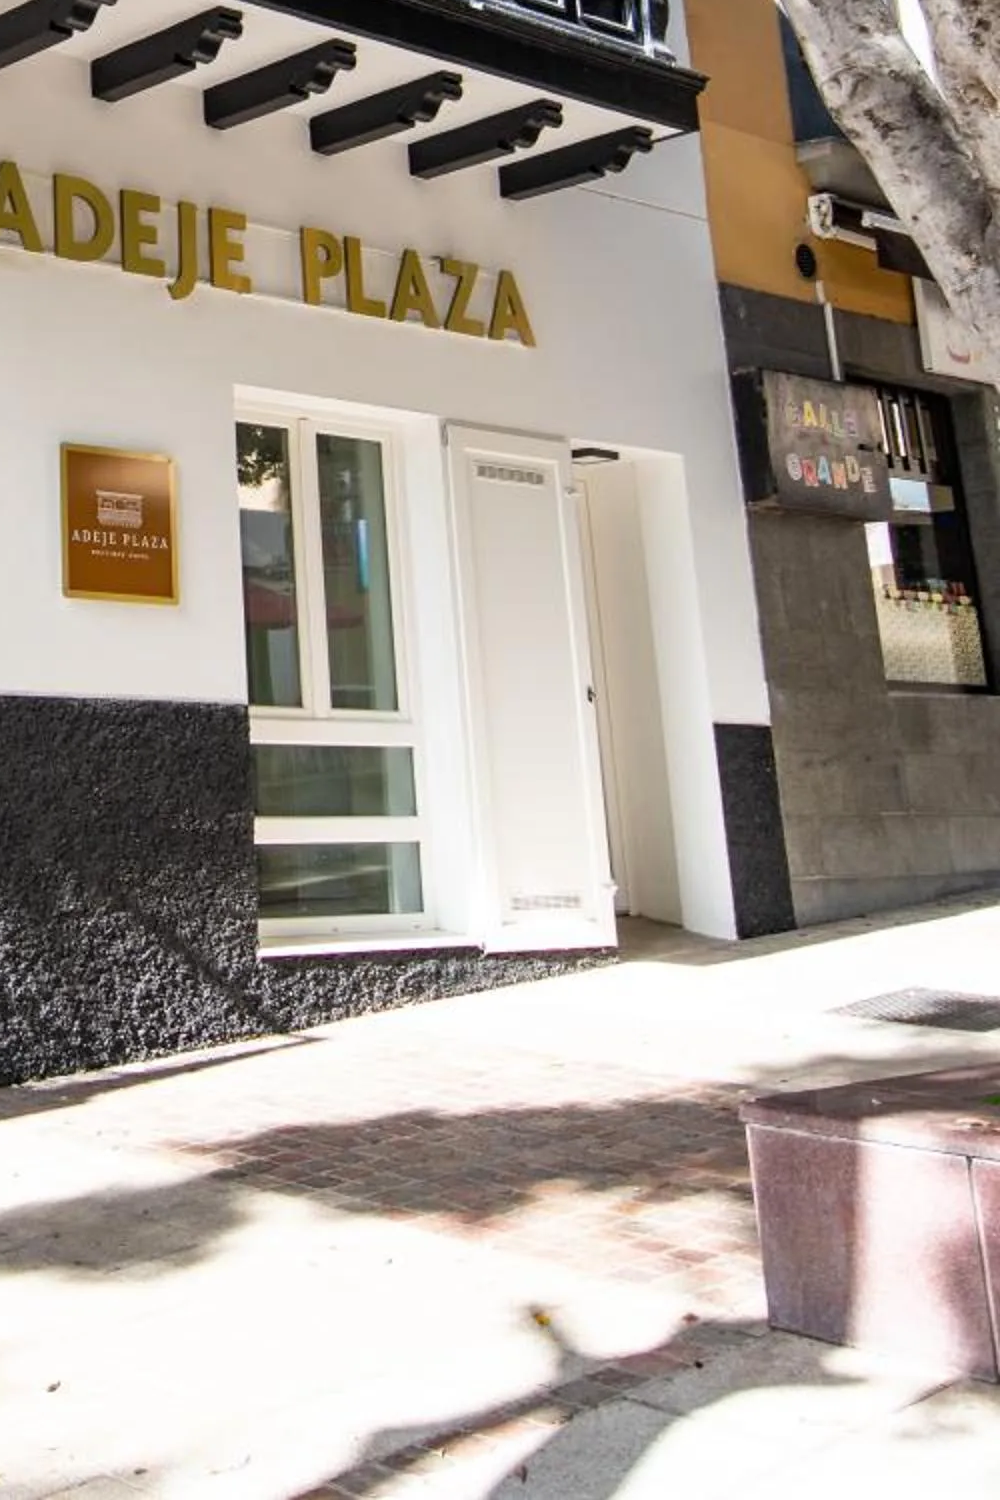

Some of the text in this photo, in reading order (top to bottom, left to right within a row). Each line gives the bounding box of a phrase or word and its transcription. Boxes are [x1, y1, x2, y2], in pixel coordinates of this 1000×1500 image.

[300, 226, 537, 348] PLAZA
[72, 529, 168, 549] ADEJE PLAZA
